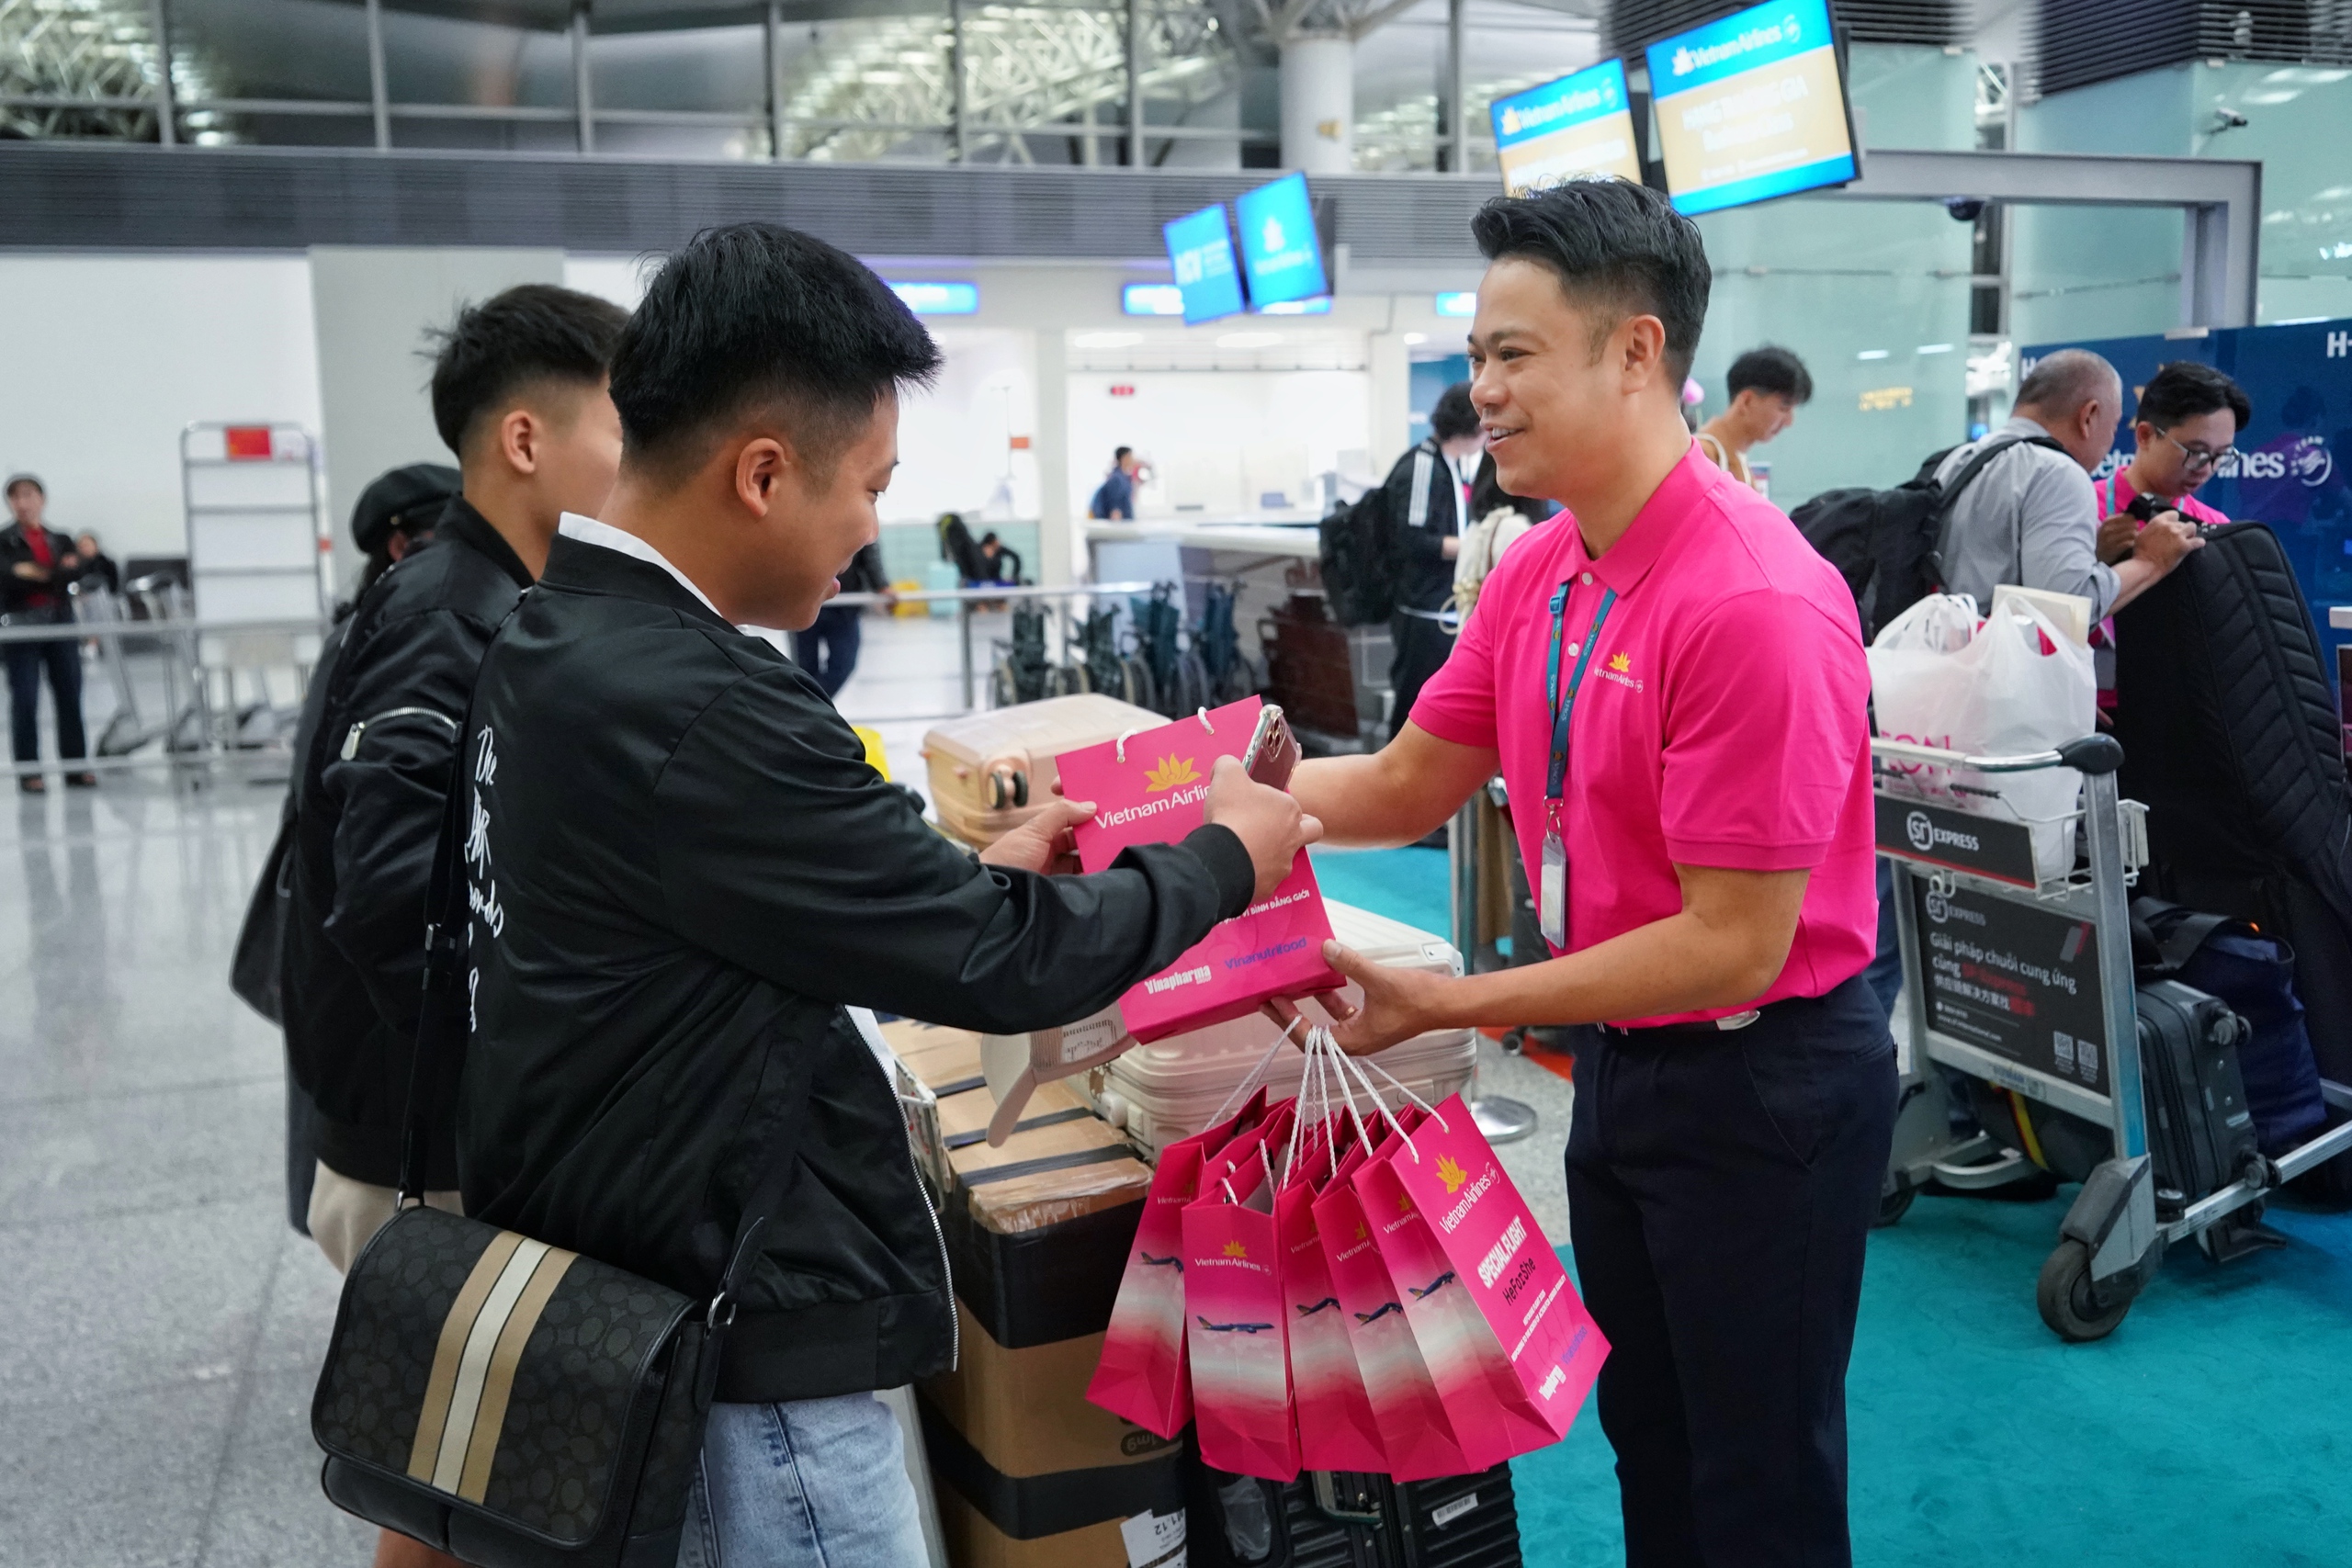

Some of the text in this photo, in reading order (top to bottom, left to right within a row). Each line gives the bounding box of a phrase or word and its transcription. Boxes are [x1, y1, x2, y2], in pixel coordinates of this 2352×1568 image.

[1094, 798, 1170, 829] Vietnam
[1934, 828, 1980, 852] EXPRESS
[1225, 937, 1306, 969] Vinanutrifood
[1954, 940, 1984, 963] pháp
[2020, 962, 2051, 987] cung
[1145, 964, 1211, 995] Vinapharma
[1438, 1174, 1492, 1235] Vietnam Airlines
[1194, 1258, 1261, 1271] Vietnam Airlines
[1477, 1214, 1528, 1290] SPECIAL FLIGHT
[1502, 1257, 1536, 1306] HeForShe
